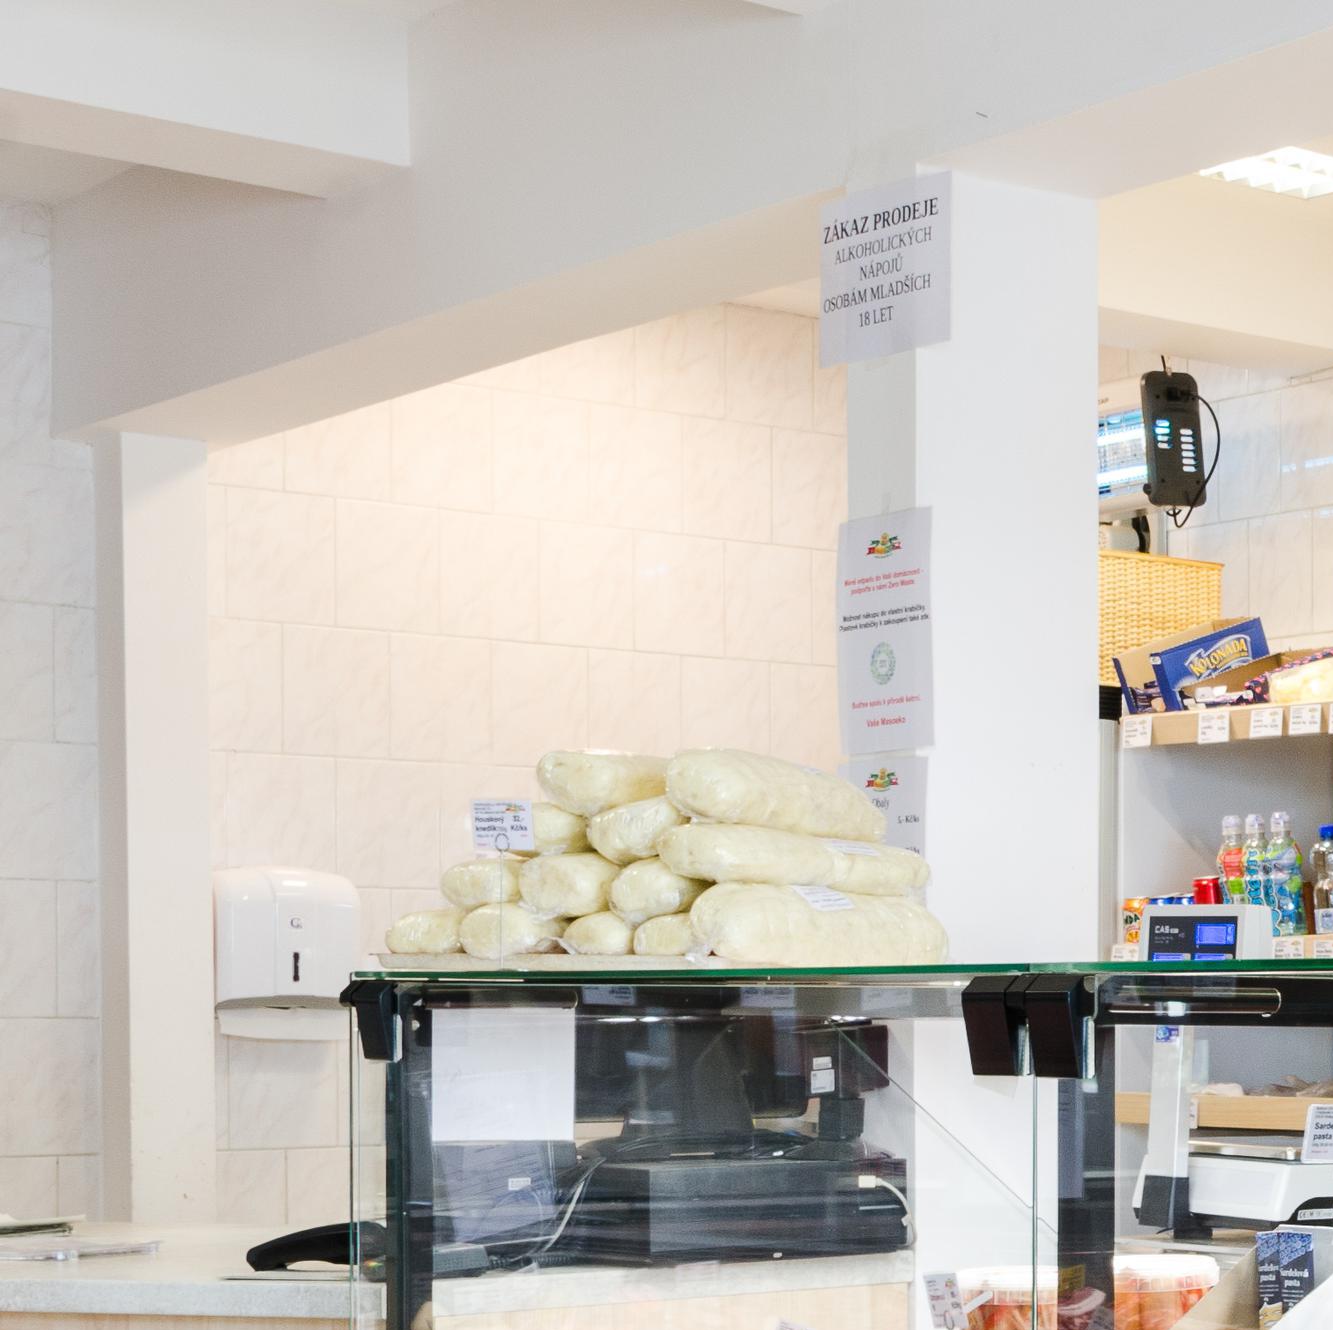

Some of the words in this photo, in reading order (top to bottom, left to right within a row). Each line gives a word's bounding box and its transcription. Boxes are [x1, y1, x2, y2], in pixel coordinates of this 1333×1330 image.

[824, 215, 869, 245] ZÁKAZ
[873, 197, 939, 232] PRODEJE
[834, 226, 932, 265] ALKOHOLICKÝCH
[859, 254, 903, 281] NÁPOJŮ
[823, 287, 868, 314] OSOBÁM
[870, 274, 931, 302] MLADŠÍCH
[858, 311, 871, 327] 18
[873, 306, 894, 325] LET
[1154, 925, 1170, 934] CAS
